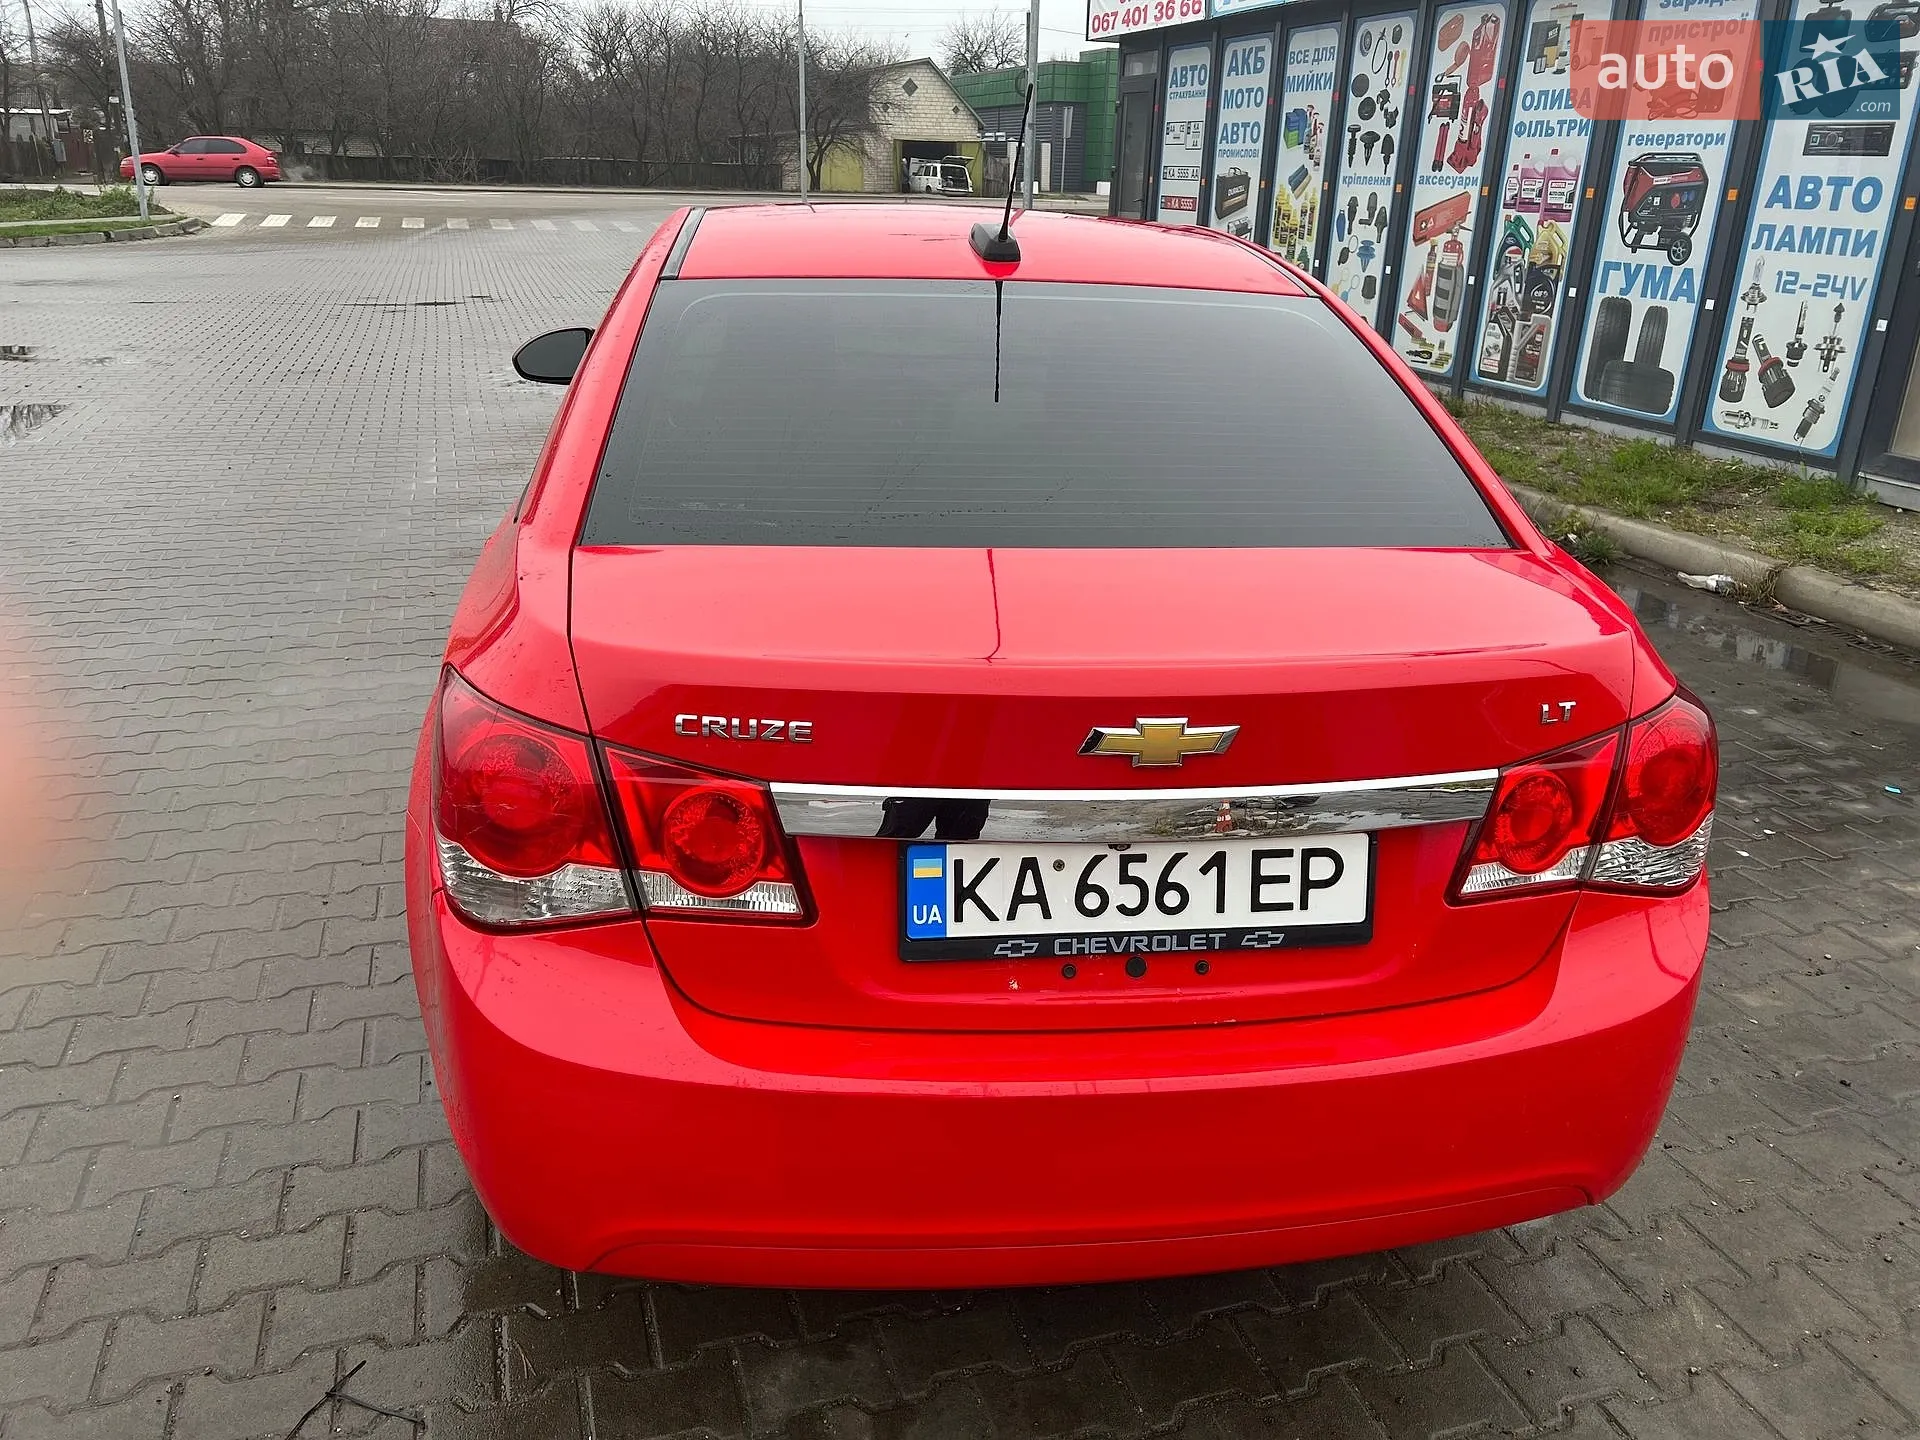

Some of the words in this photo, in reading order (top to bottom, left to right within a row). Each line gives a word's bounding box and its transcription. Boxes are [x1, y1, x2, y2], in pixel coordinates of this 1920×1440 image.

[1091, 11, 1119, 33] 067
[1121, 5, 1149, 28] 401
[1153, 0, 1176, 22] 36
[1180, 0, 1203, 17] 66
[1227, 46, 1266, 77] АКБ
[1288, 49, 1310, 65] ВСЕ
[1312, 46, 1336, 65] ДЛЯ
[1169, 64, 1208, 88] АВТО
[1285, 70, 1334, 92] МИЙКИ
[1223, 87, 1265, 109] МОТО
[1522, 87, 1592, 111] ОЛИВА
[1219, 121, 1261, 144] АВТО
[1514, 119, 1591, 137] ФІЛЬТРИ
[1627, 132, 1726, 150] генератори
[1218, 149, 1260, 159] ПРОМИСЛОВІ
[1342, 173, 1391, 187] кріплення
[1418, 174, 1479, 189] аксесуари
[1764, 175, 1884, 213] АВТО
[1751, 223, 1878, 259] ЛАМПИ
[1597, 260, 1697, 303] ГУМА
[1775, 270, 1868, 301] 12-24V
[1541, 701, 1577, 723] LT
[675, 714, 813, 743] CRUZE
[953, 856, 1053, 923] KA
[1074, 850, 1227, 918] 6561
[1250, 847, 1344, 913] EP
[912, 905, 942, 925] UA
[1054, 932, 1227, 956] CHEVROLET
